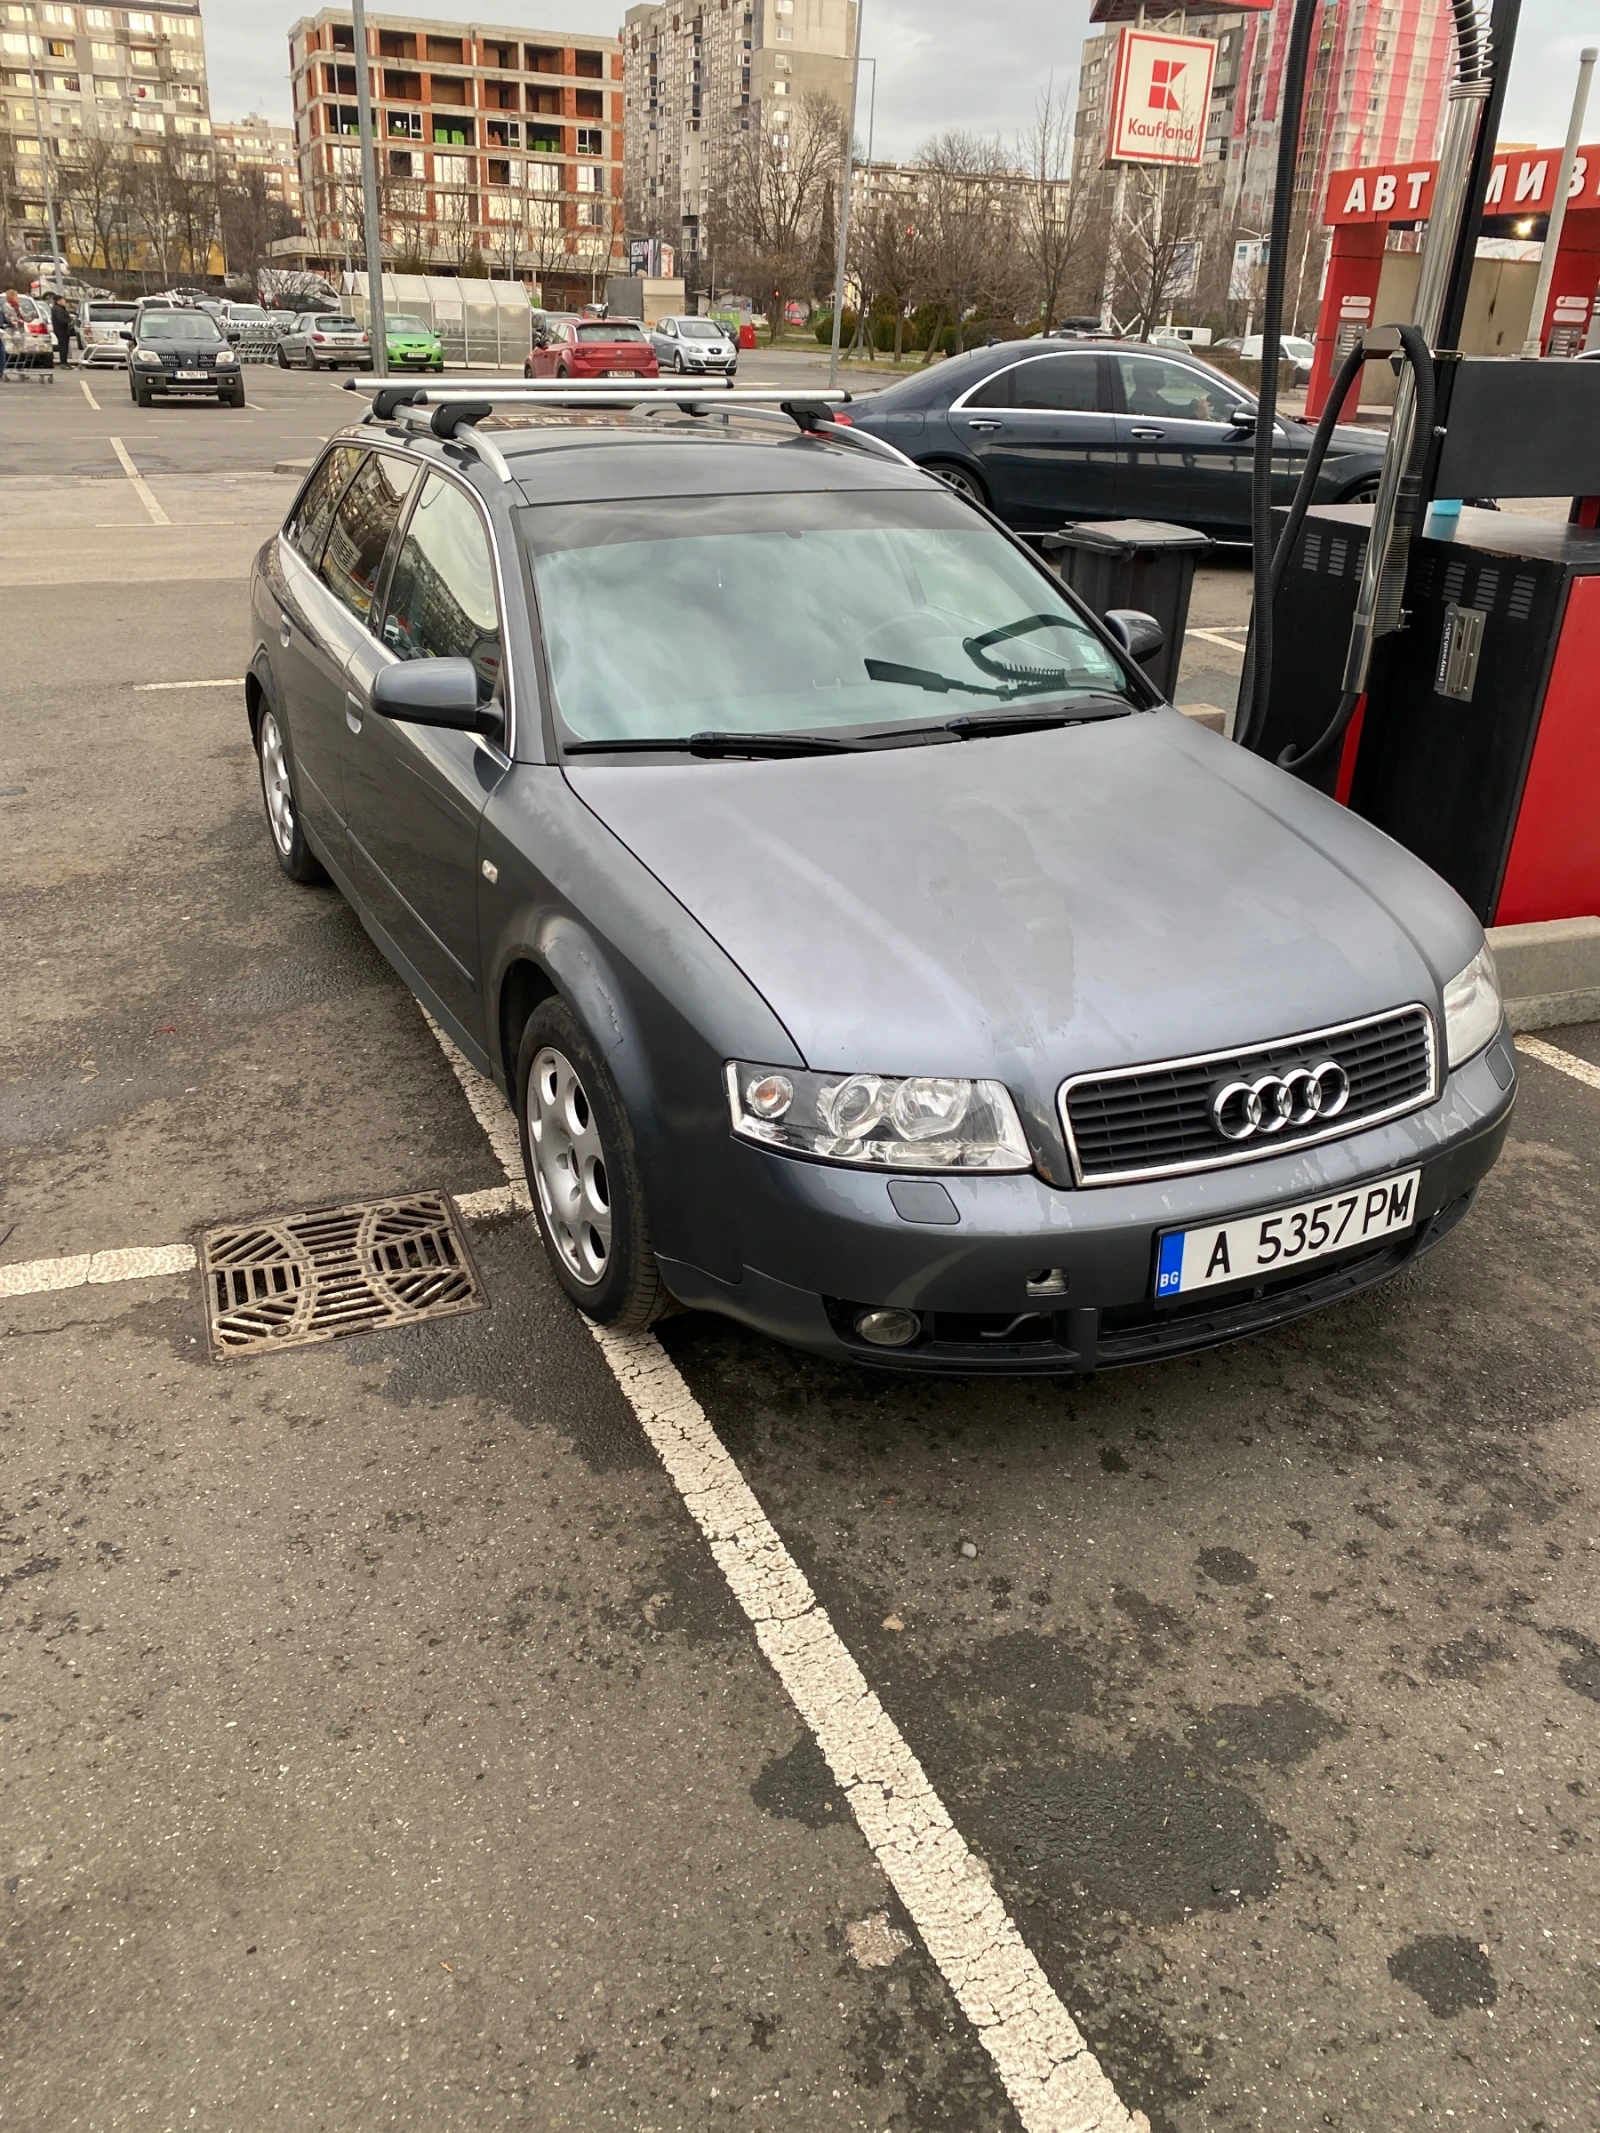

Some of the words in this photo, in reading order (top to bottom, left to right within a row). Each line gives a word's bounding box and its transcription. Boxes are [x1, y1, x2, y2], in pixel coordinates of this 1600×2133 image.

[1128, 117, 1194, 141] Kaufland
[1205, 1230, 1231, 1279] A
[1257, 1196, 1358, 1265] 5357
[1361, 1178, 1414, 1235] PM
[1159, 1271, 1179, 1288] BG
